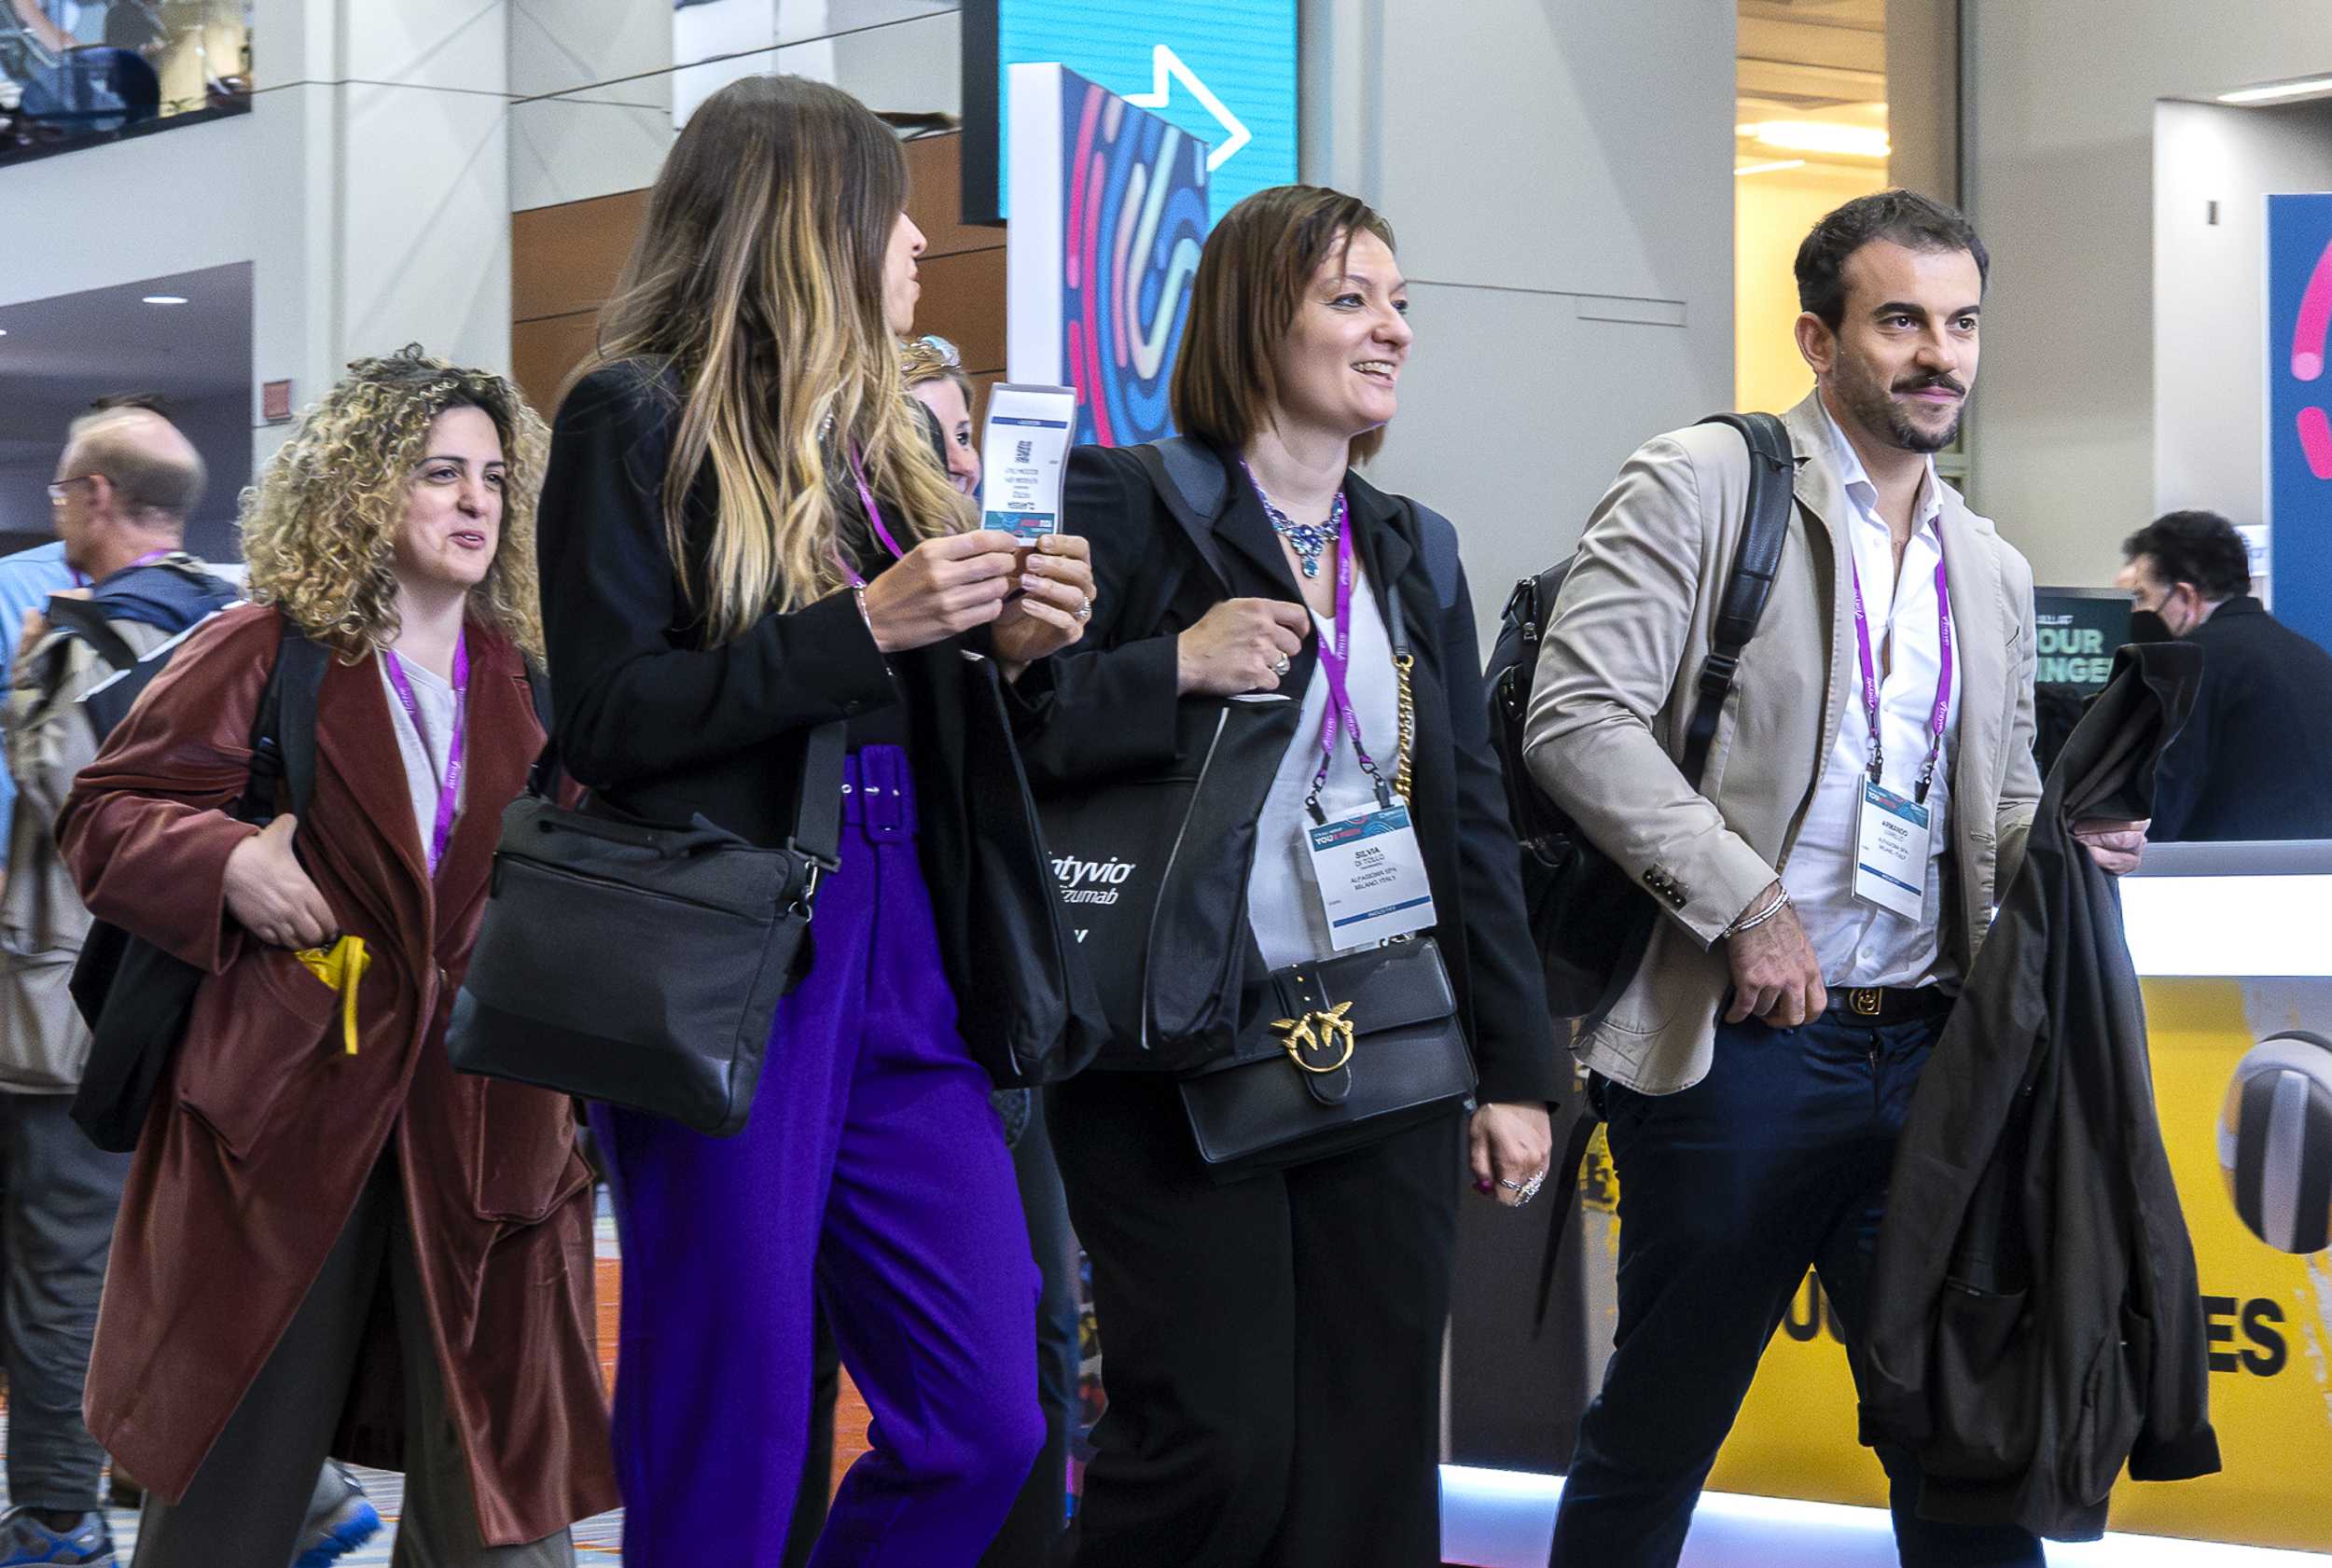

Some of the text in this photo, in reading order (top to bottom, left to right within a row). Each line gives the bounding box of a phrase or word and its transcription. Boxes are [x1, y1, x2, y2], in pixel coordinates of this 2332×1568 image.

[2037, 628, 2103, 654] OUR
[1059, 885, 1119, 906] zumab
[2200, 1296, 2287, 1378] ES
